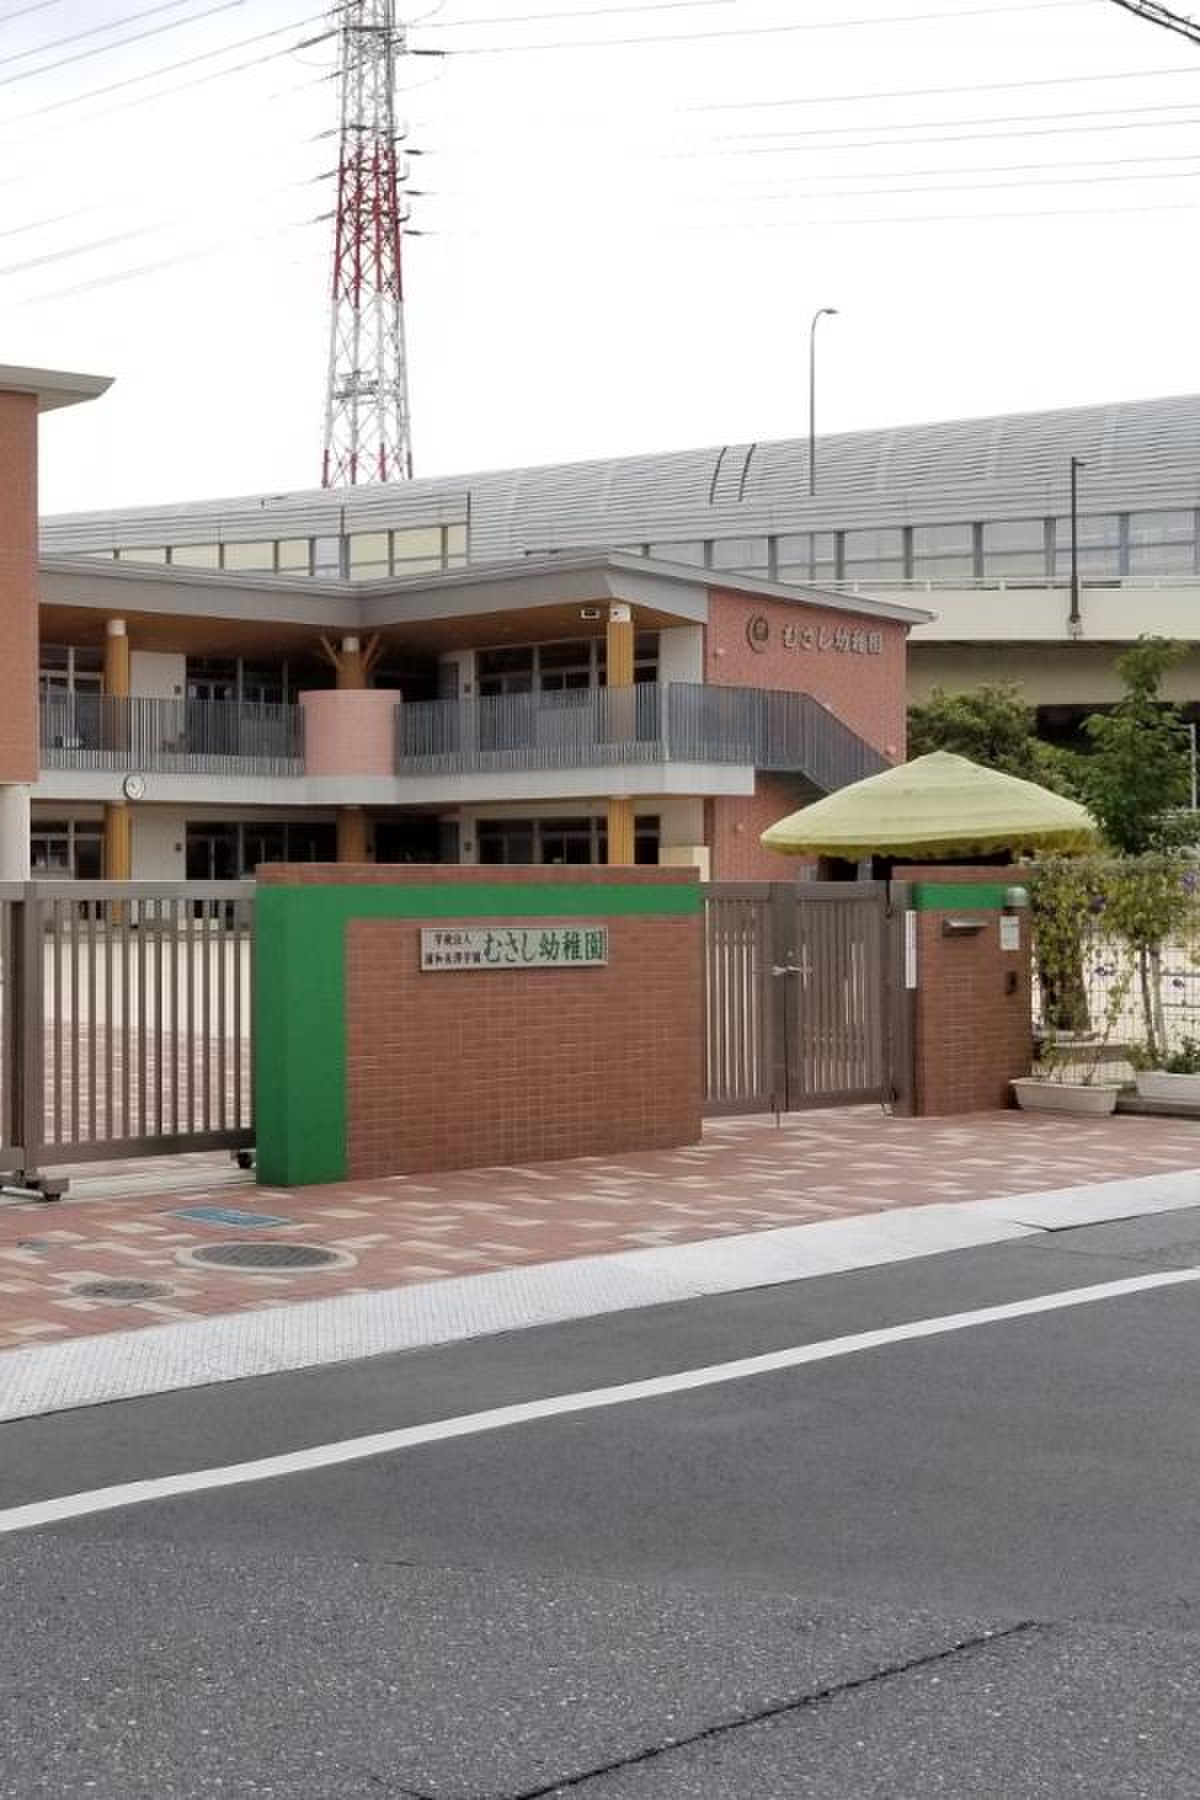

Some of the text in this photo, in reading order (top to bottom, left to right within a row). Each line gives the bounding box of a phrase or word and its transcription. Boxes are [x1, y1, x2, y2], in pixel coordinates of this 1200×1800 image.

[482, 931, 603, 963] むさし幼稚園
